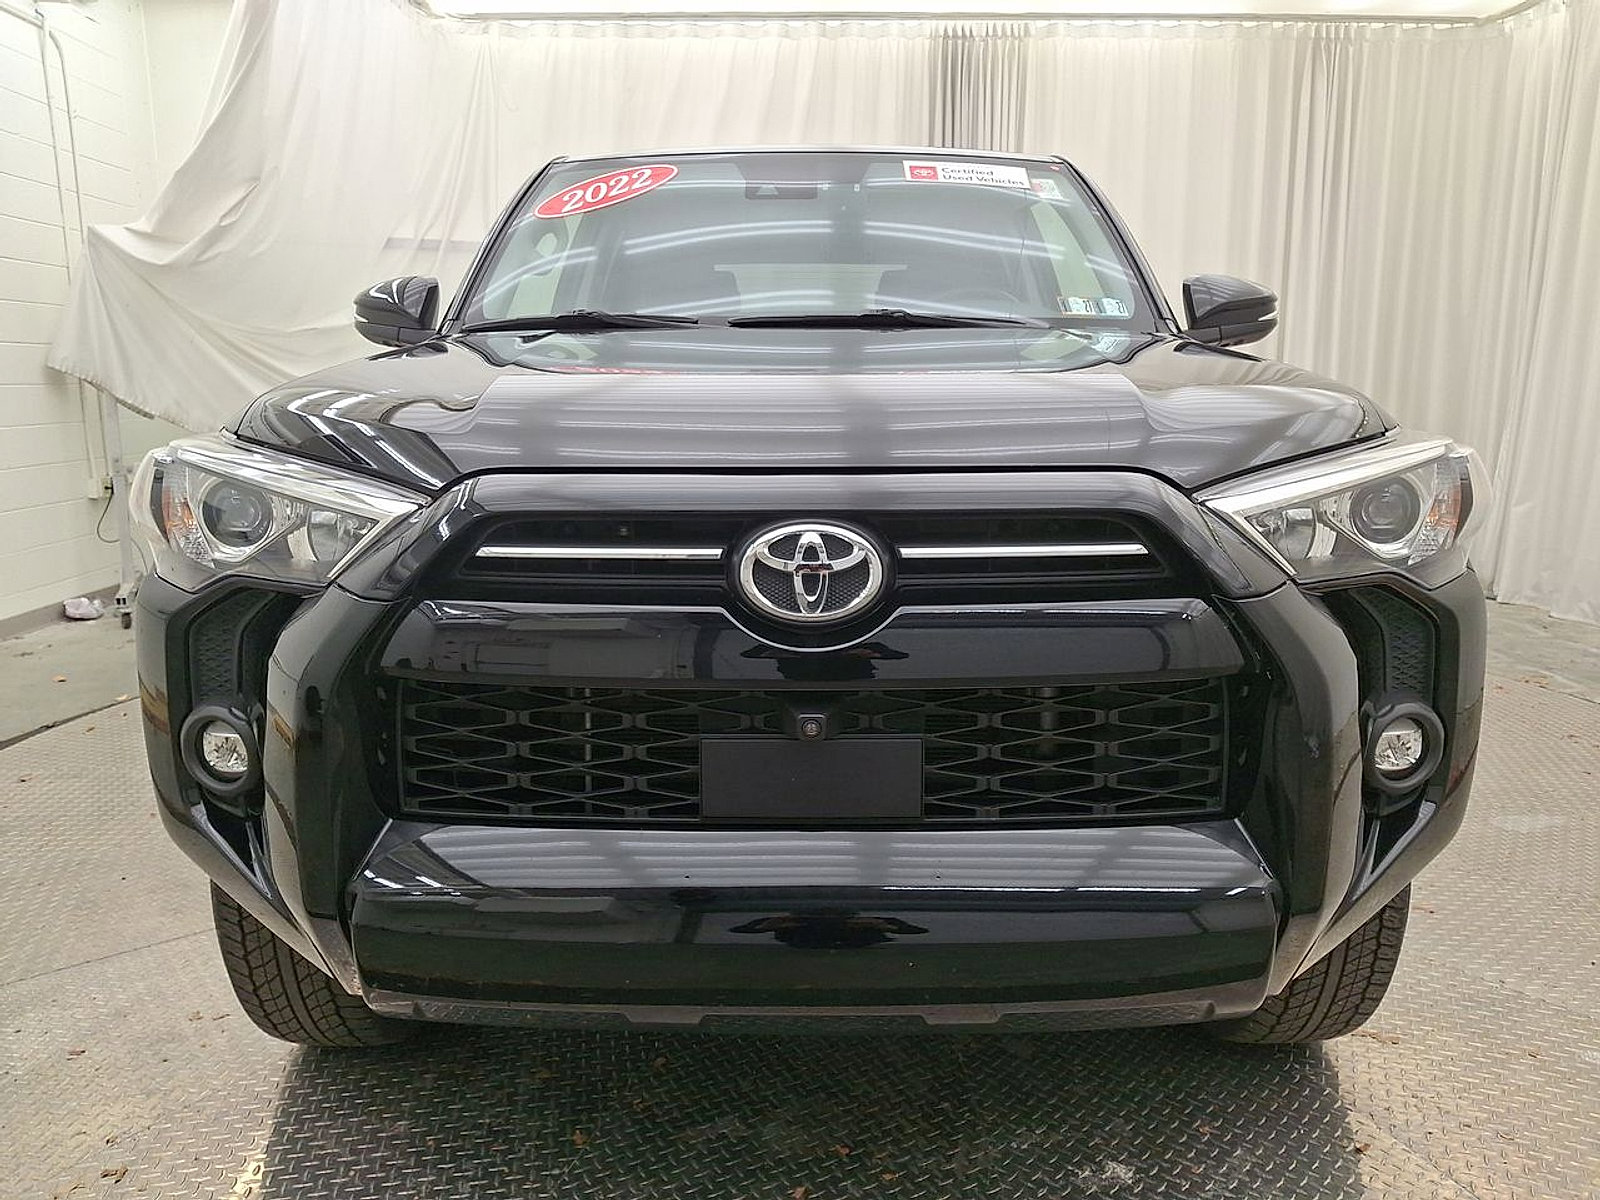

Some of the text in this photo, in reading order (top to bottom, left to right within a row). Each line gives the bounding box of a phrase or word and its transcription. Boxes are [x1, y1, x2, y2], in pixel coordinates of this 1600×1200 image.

[941, 167, 994, 176] Certified
[943, 174, 1025, 186] Used Vehicles
[561, 169, 652, 213] 2022
